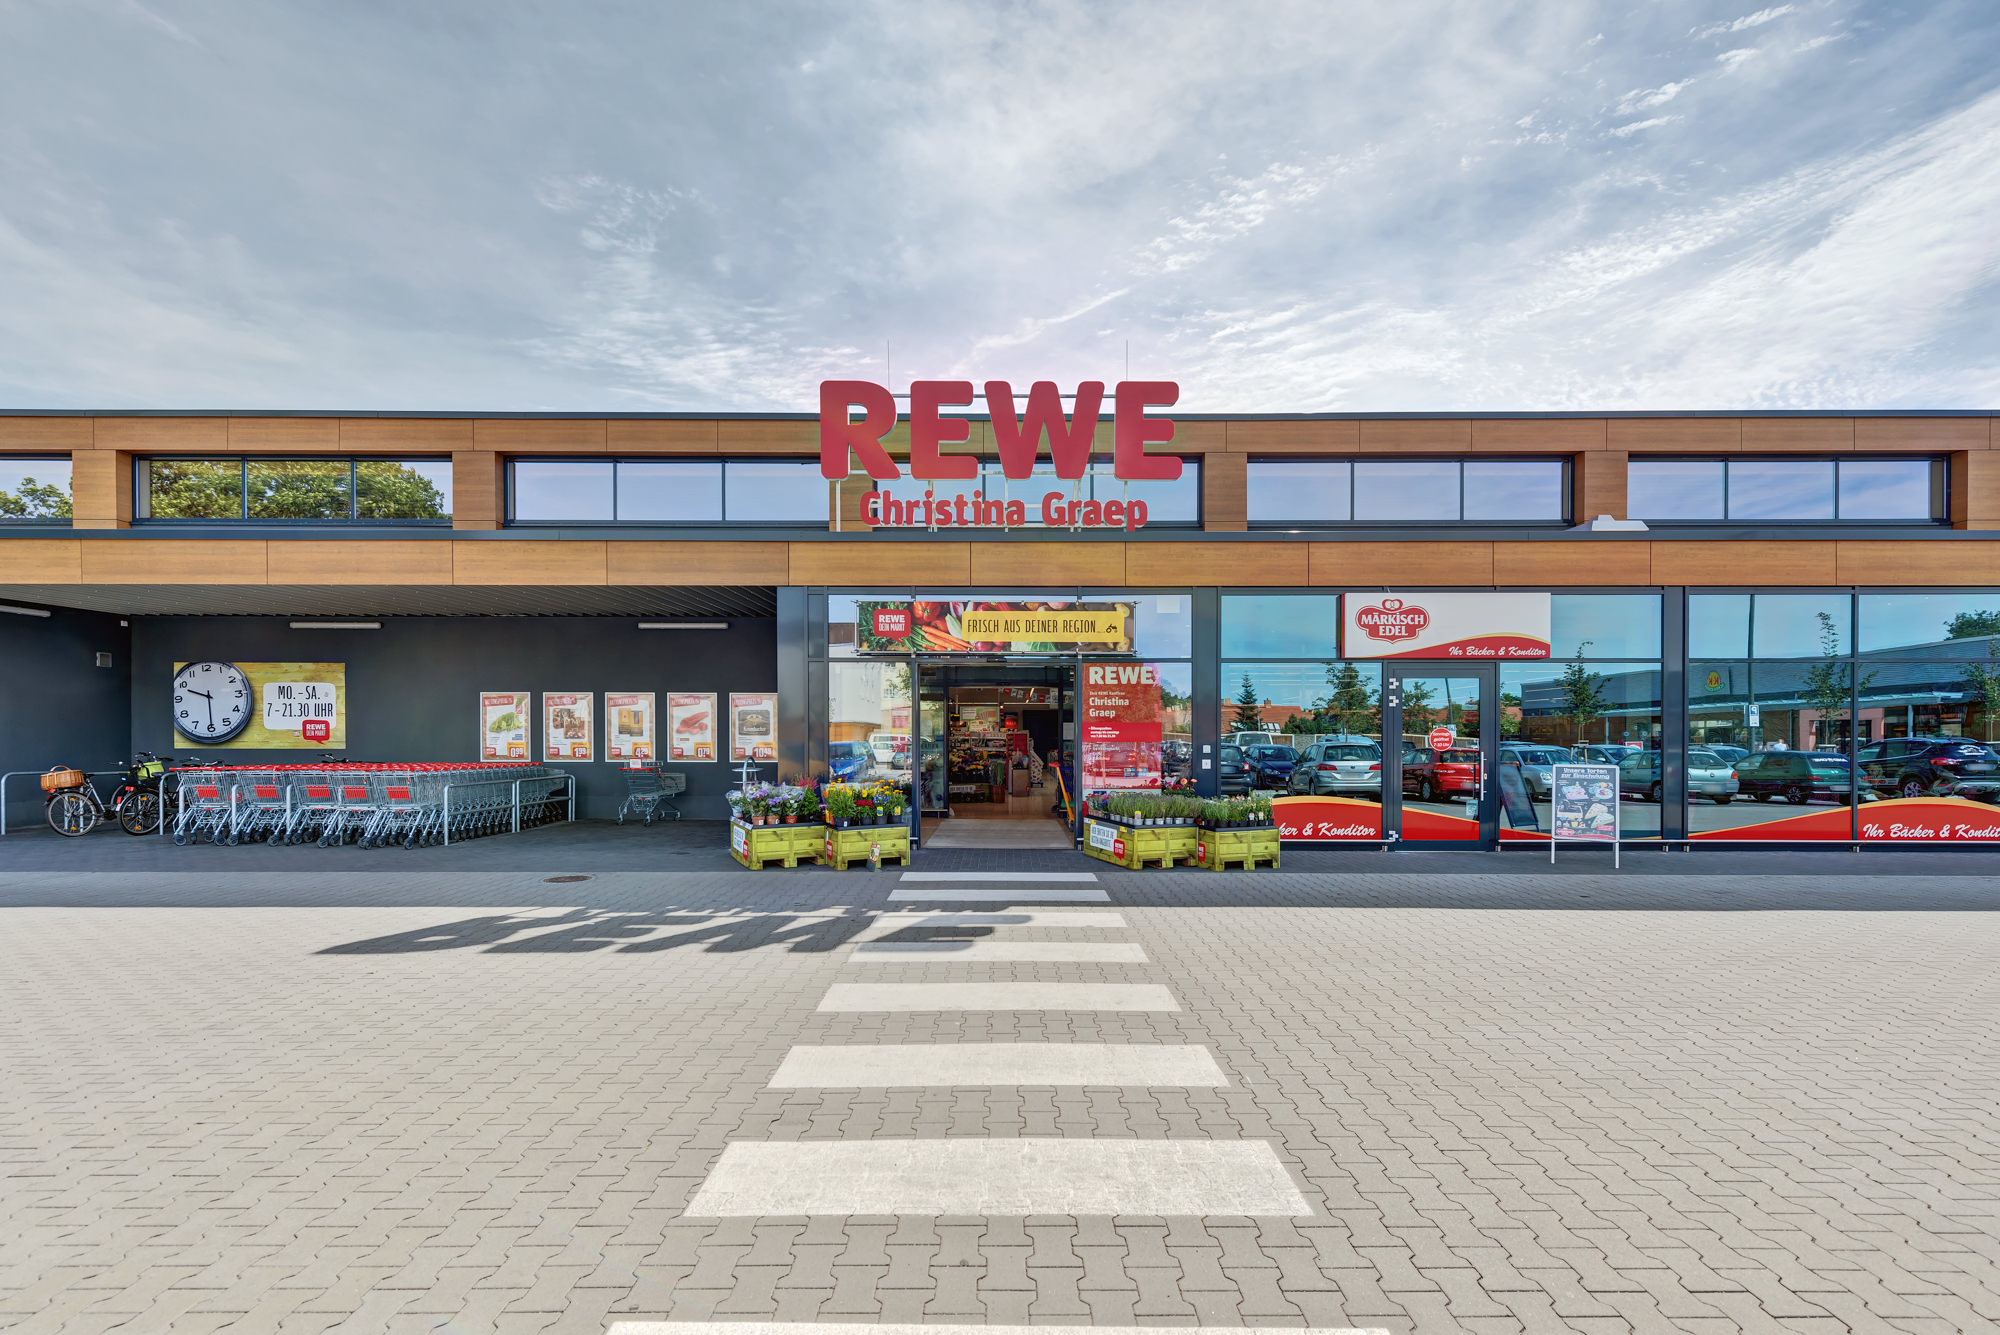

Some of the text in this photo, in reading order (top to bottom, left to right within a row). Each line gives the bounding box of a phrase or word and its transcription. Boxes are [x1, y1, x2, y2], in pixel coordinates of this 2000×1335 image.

[820, 380, 1183, 480] REWE
[859, 490, 1148, 532] Christina Graep
[878, 614, 905, 623] REWE
[1360, 612, 1424, 625] MÄRKISCH
[878, 623, 905, 632] DEIN MARKT
[967, 619, 1096, 633] FRISCH AUS DEINER REGION
[1379, 625, 1408, 636] EDEL
[1449, 646, 1547, 656] Ihr Bäcker & Konditor
[202, 664, 212, 672] 12
[1089, 666, 1154, 685] REWE
[179, 681, 188, 689] 10
[234, 690, 243, 698] 3
[1089, 697, 1129, 706] Christina
[180, 710, 189, 718] 8
[314, 703, 333, 717] UHR
[1089, 708, 1116, 718] Graep
[192, 720, 199, 729] 7
[222, 718, 232, 726] 5
[207, 724, 216, 732] 6
[1279, 822, 1376, 836] ker & Konditor
[1863, 823, 2000, 838] Ihr Bäcker & Kondit
